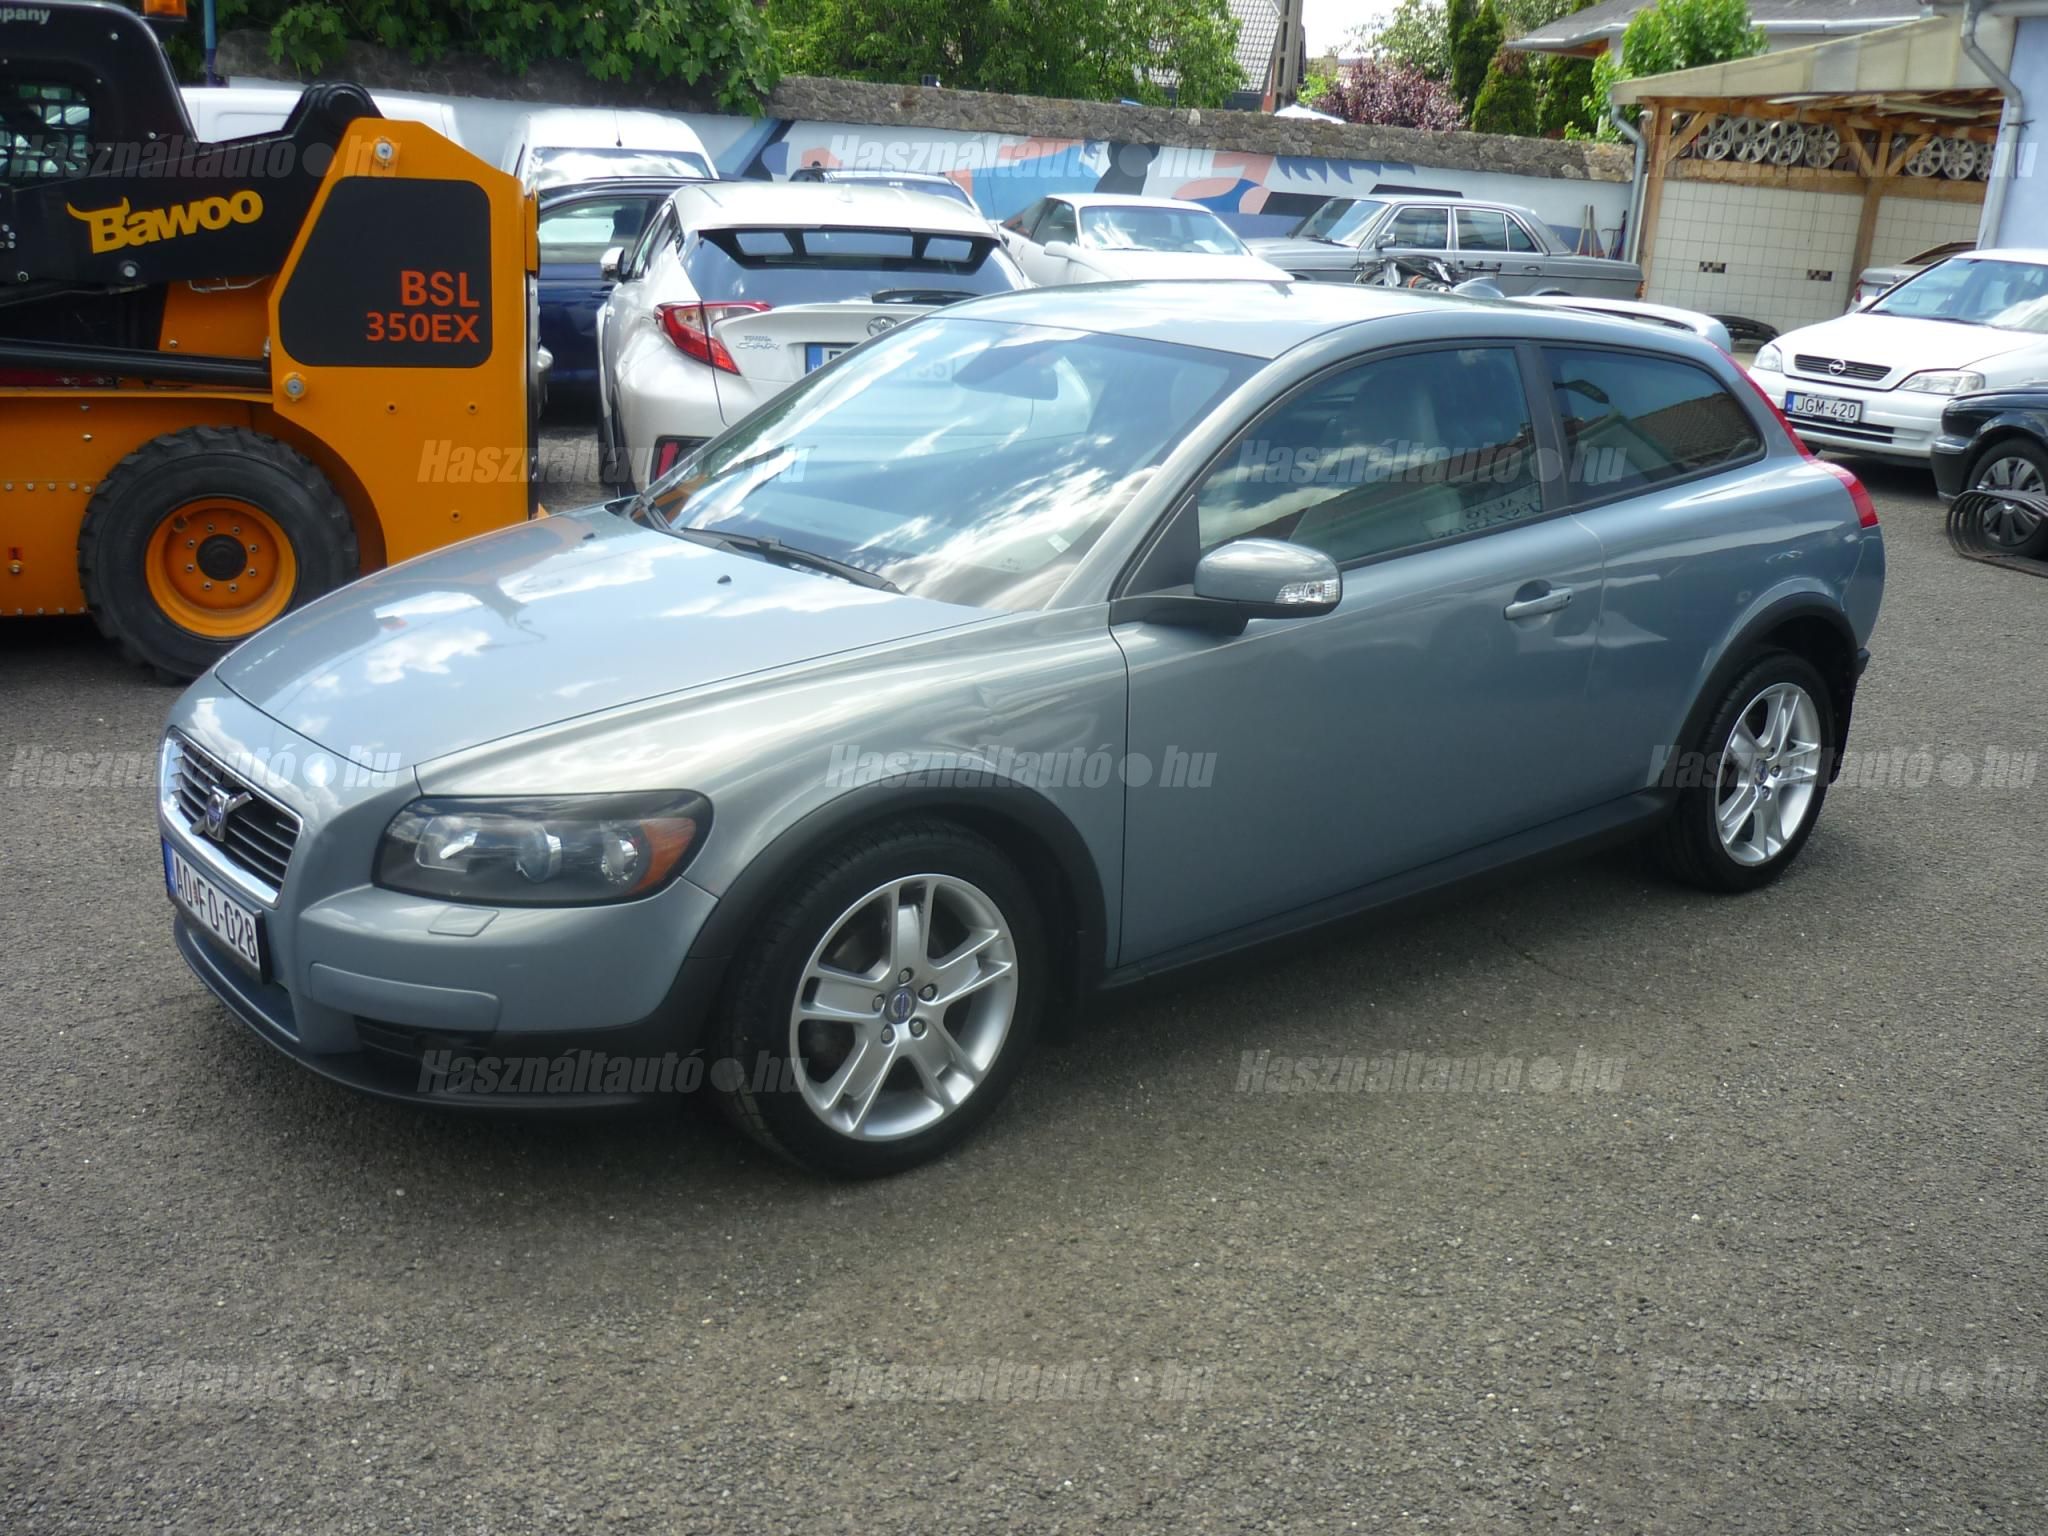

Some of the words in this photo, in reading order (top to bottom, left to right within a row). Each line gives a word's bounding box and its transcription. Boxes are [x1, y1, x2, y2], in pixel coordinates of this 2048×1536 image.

[400, 270, 480, 308] BSL
[365, 312, 480, 343] 350EX
[1796, 397, 1857, 419] JGM-420
